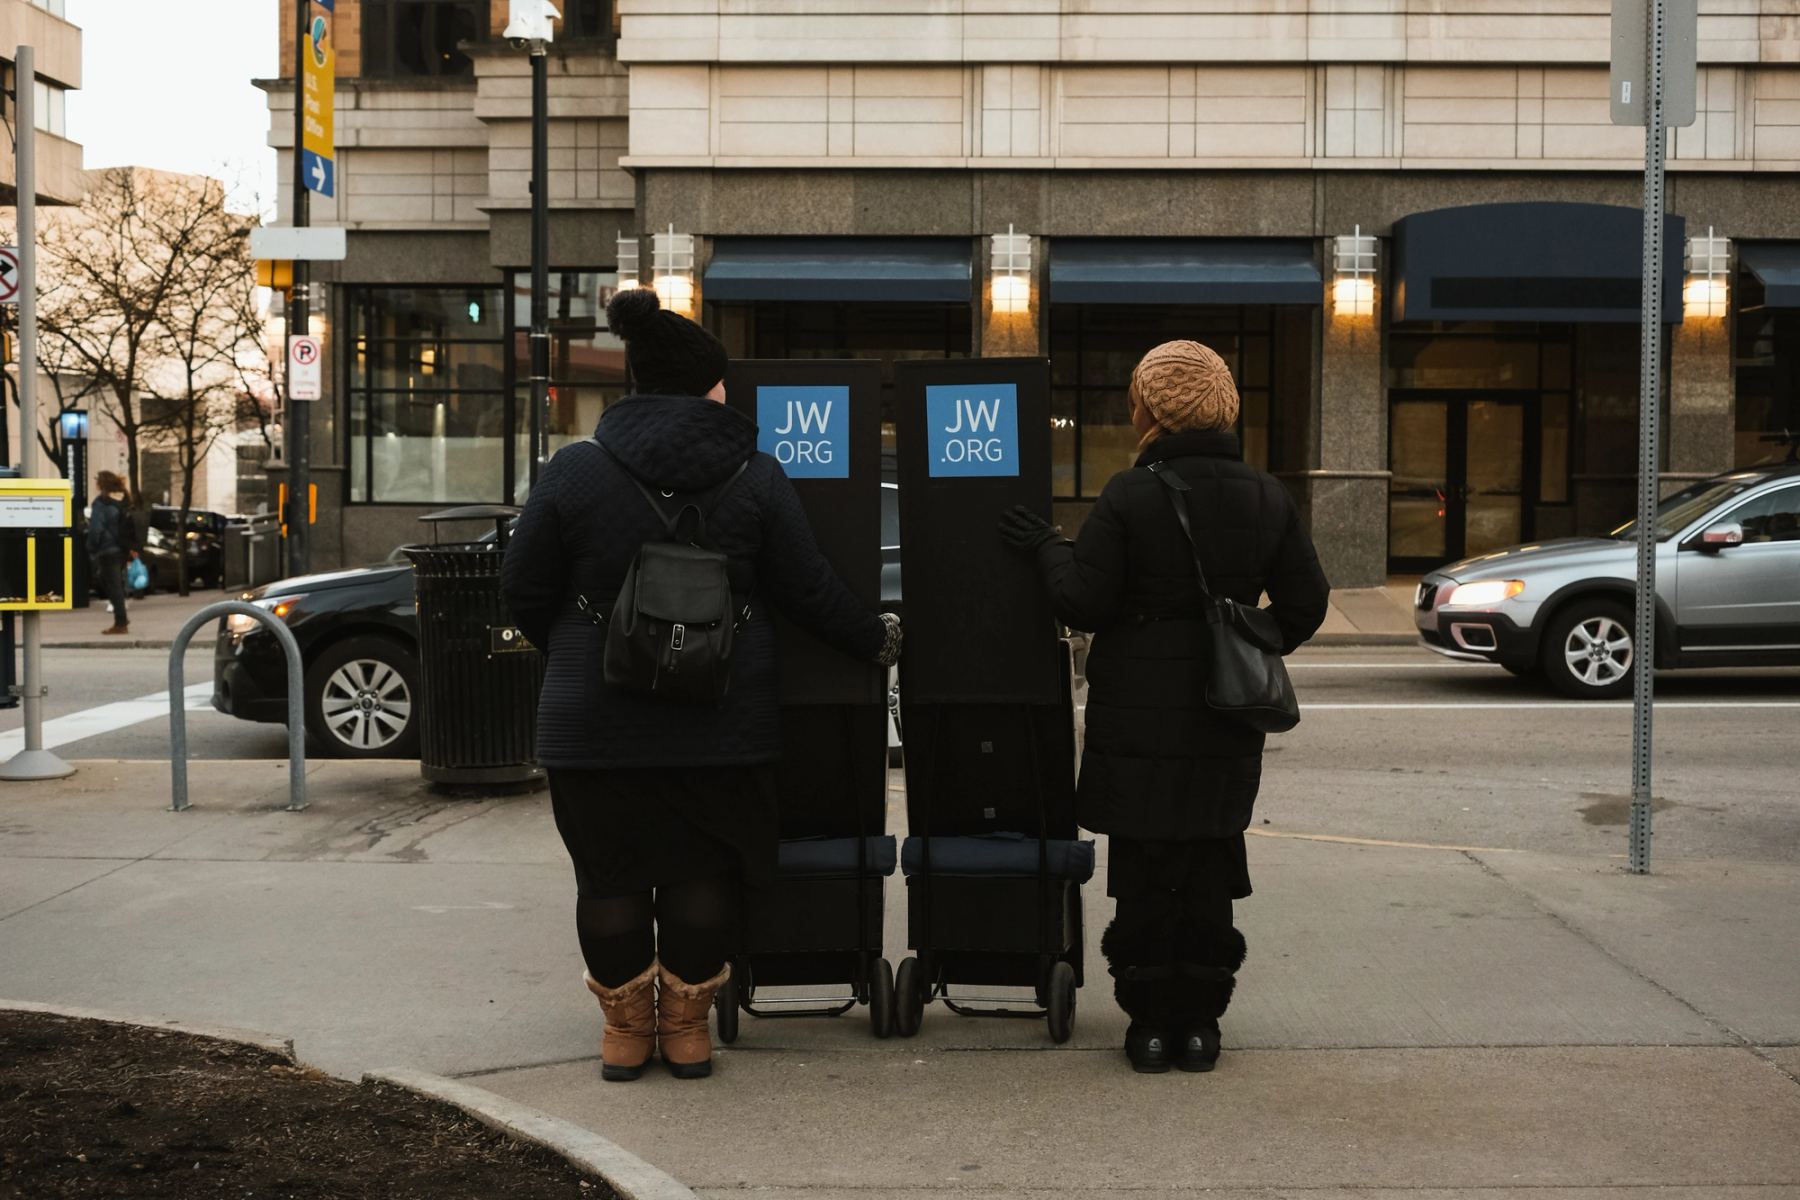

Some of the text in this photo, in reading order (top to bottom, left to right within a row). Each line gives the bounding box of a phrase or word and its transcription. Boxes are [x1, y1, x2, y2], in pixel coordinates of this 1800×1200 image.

[300, 345, 311, 360] P
[775, 401, 832, 434] JW
[945, 399, 1000, 433] JW
[775, 440, 833, 464] ORG
[941, 439, 1002, 463] .ORG
